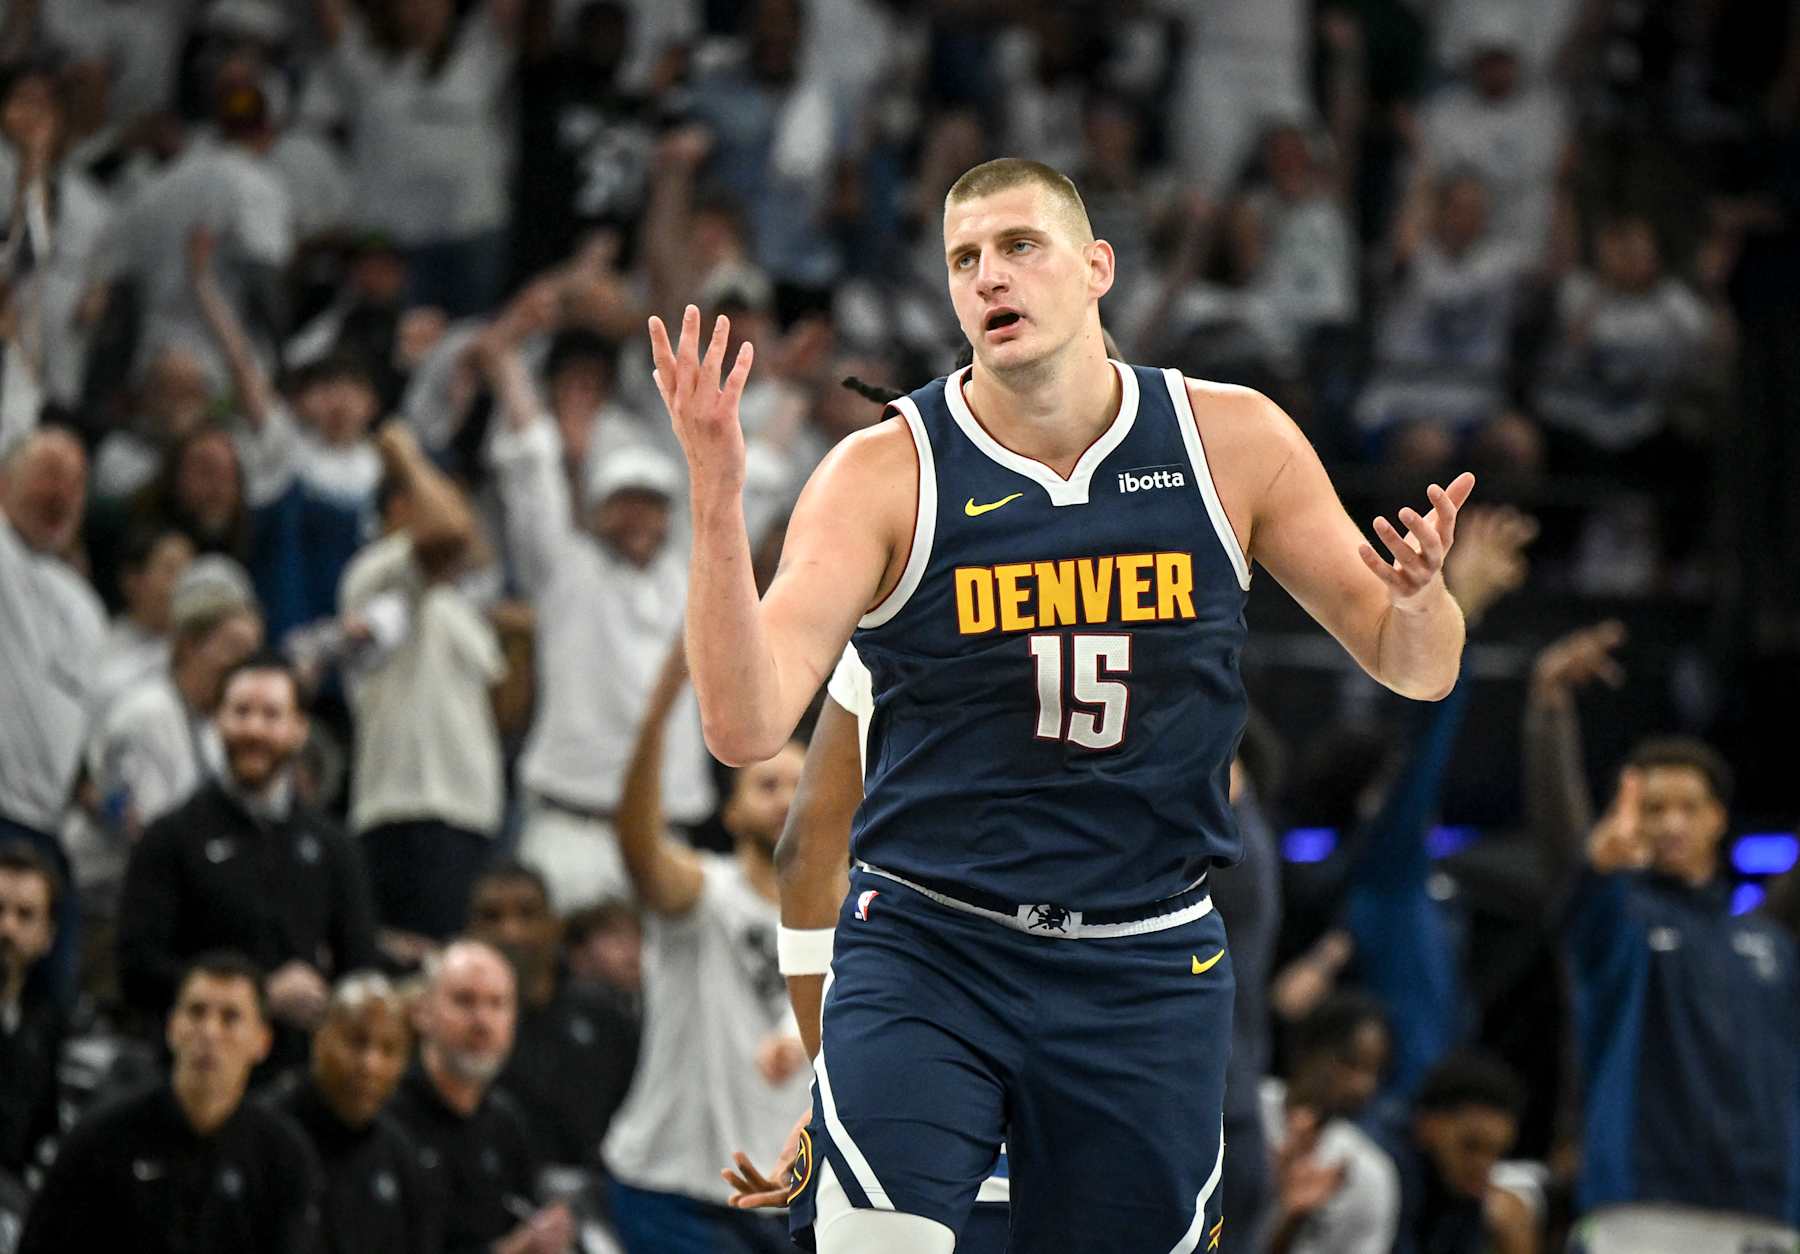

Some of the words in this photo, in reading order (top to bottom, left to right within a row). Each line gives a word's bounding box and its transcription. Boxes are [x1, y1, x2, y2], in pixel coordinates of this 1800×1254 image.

[1118, 470, 1185, 493] ibotta
[954, 552, 1197, 635] DENVER
[1029, 633, 1132, 750] 15
